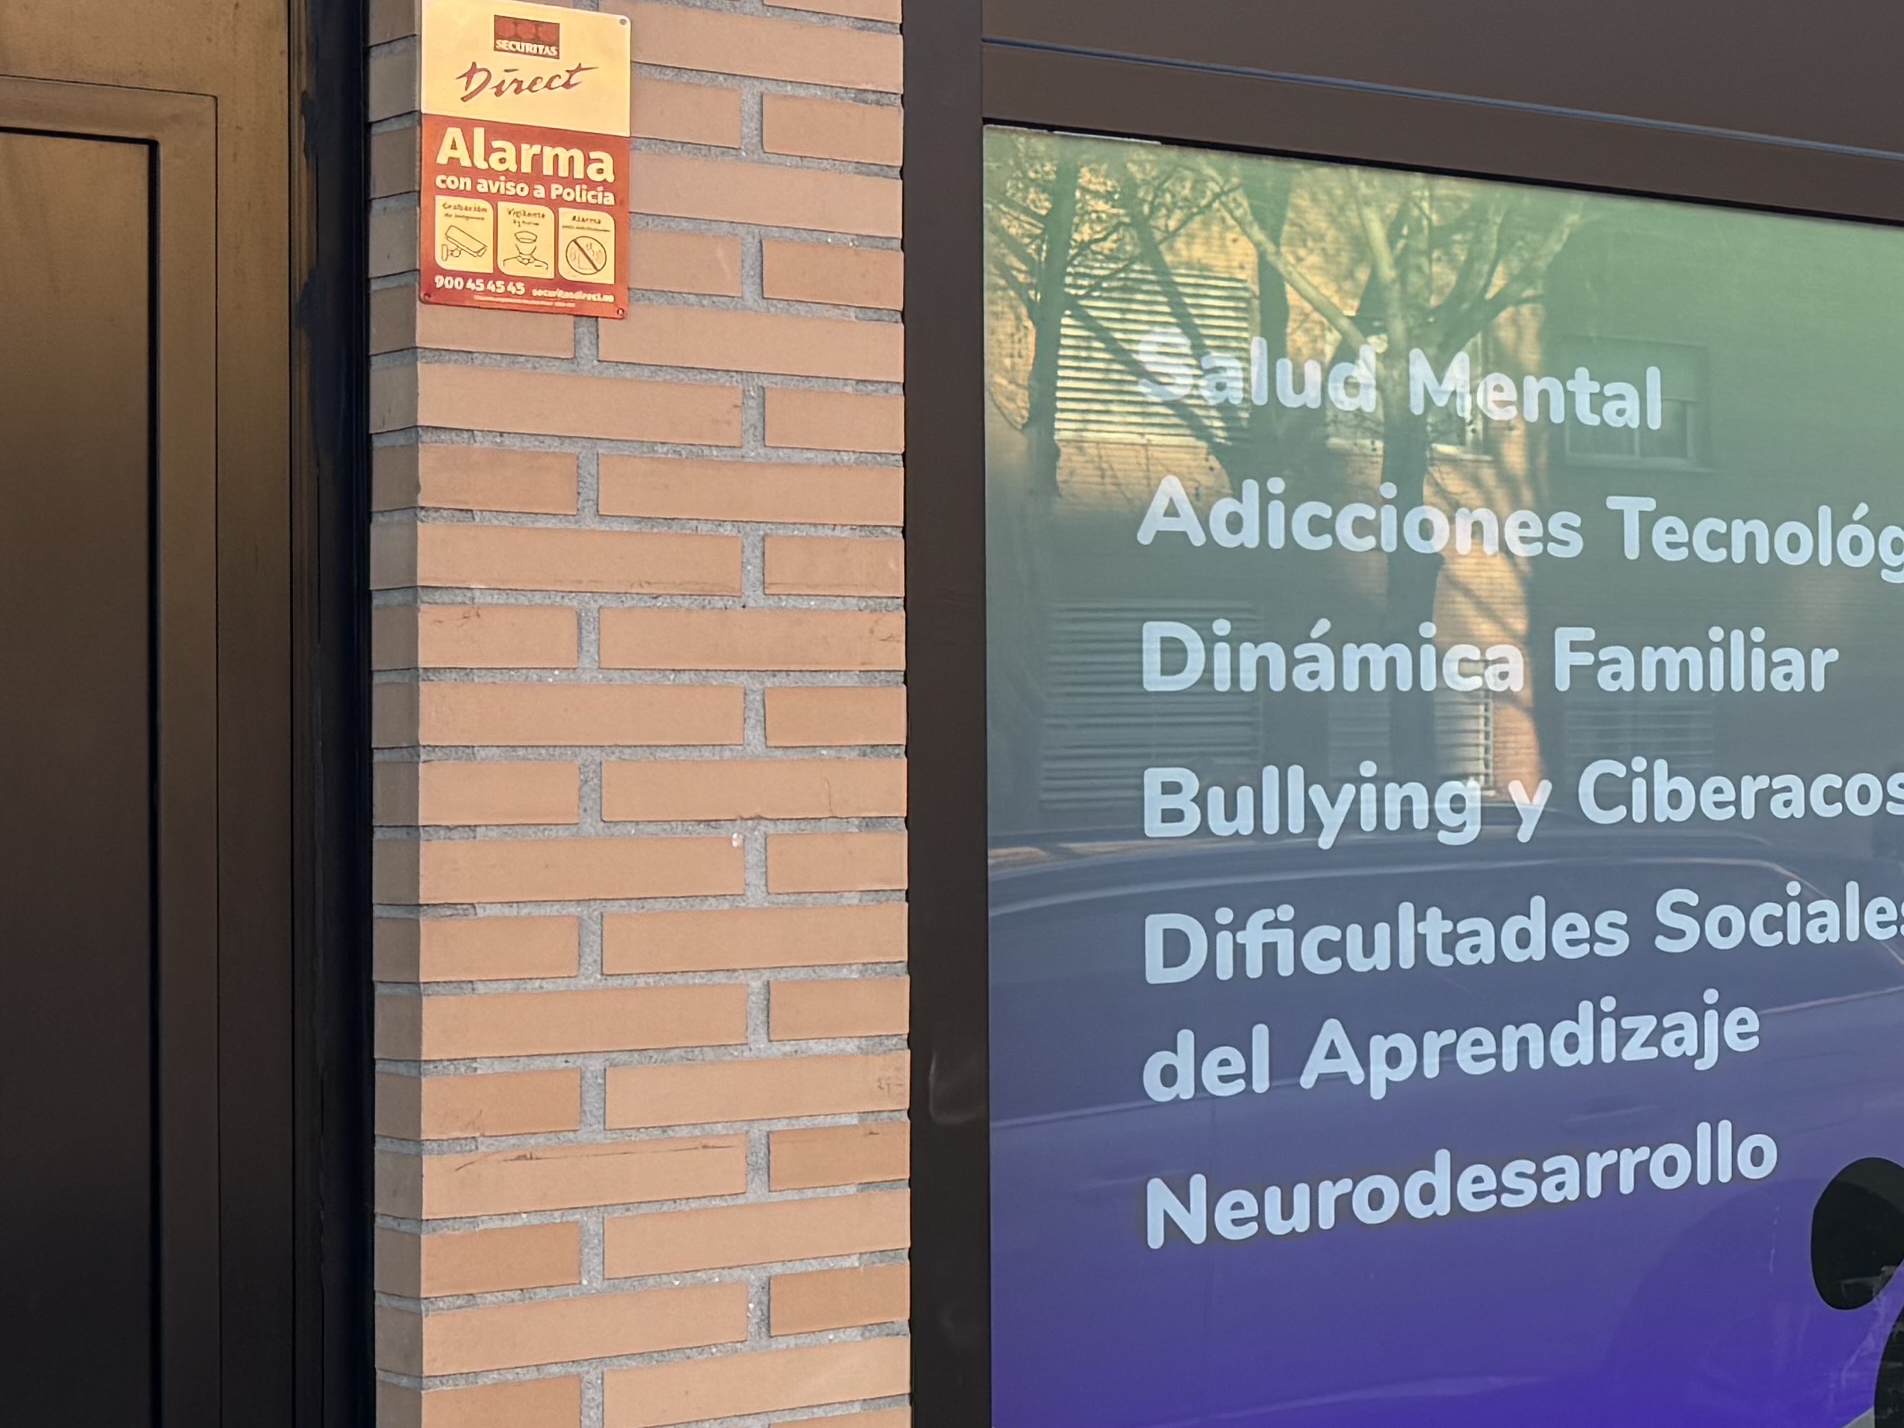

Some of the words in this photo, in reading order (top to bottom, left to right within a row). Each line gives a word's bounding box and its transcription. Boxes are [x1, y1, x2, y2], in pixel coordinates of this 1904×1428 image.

[456, 61, 599, 103] Direct
[495, 39, 558, 57] SECURITAS
[435, 127, 615, 183] Alarma
[435, 174, 472, 191] con
[476, 176, 529, 198] aviso
[533, 185, 545, 199] a
[435, 275, 464, 289] 900
[466, 278, 485, 291] 45
[487, 280, 505, 293] 45
[507, 282, 525, 295] 45
[1139, 325, 1376, 412] Salud
[1411, 348, 1662, 430] Mental
[1137, 475, 1583, 559] Adicciones
[1142, 617, 1523, 692] Dinámica
[1554, 626, 1838, 693] Familiar
[1143, 761, 1482, 849] Bullying
[1508, 777, 1551, 842] y
[1144, 896, 1629, 984] Dificultades
[1143, 1023, 1270, 1102] del
[1300, 990, 1760, 1099] Aprendizaje
[1145, 1119, 1778, 1248] Neurodesarrollo
